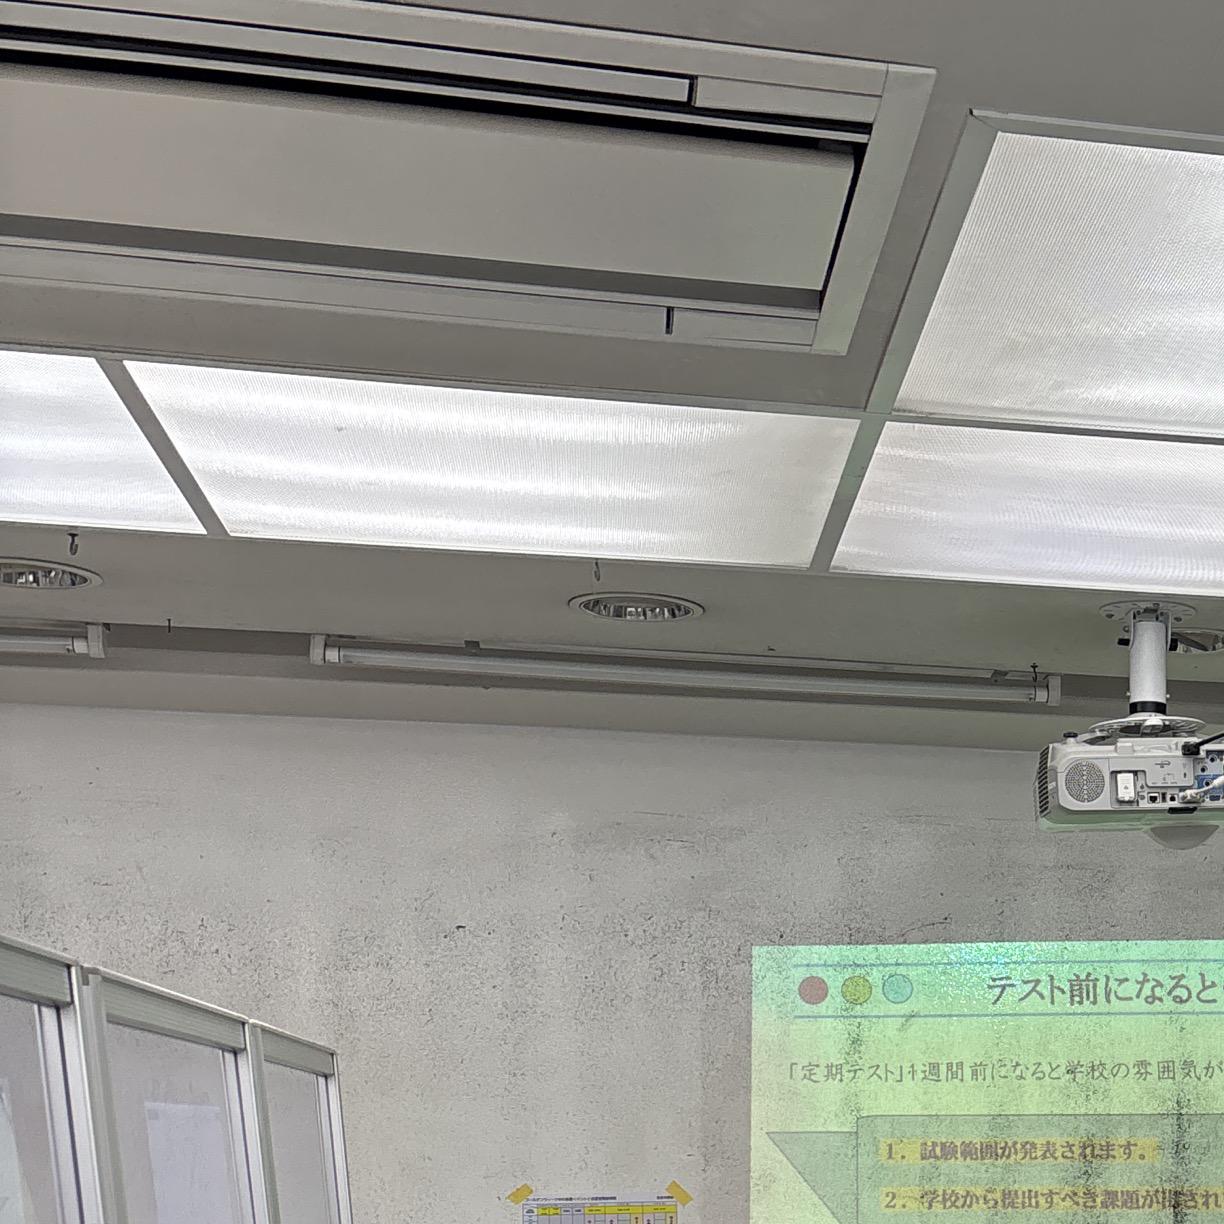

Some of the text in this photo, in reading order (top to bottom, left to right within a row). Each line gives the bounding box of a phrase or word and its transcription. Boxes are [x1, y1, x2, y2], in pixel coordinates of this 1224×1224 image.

[920, 1140, 1146, 1161] 試験範囲が発表されます。
